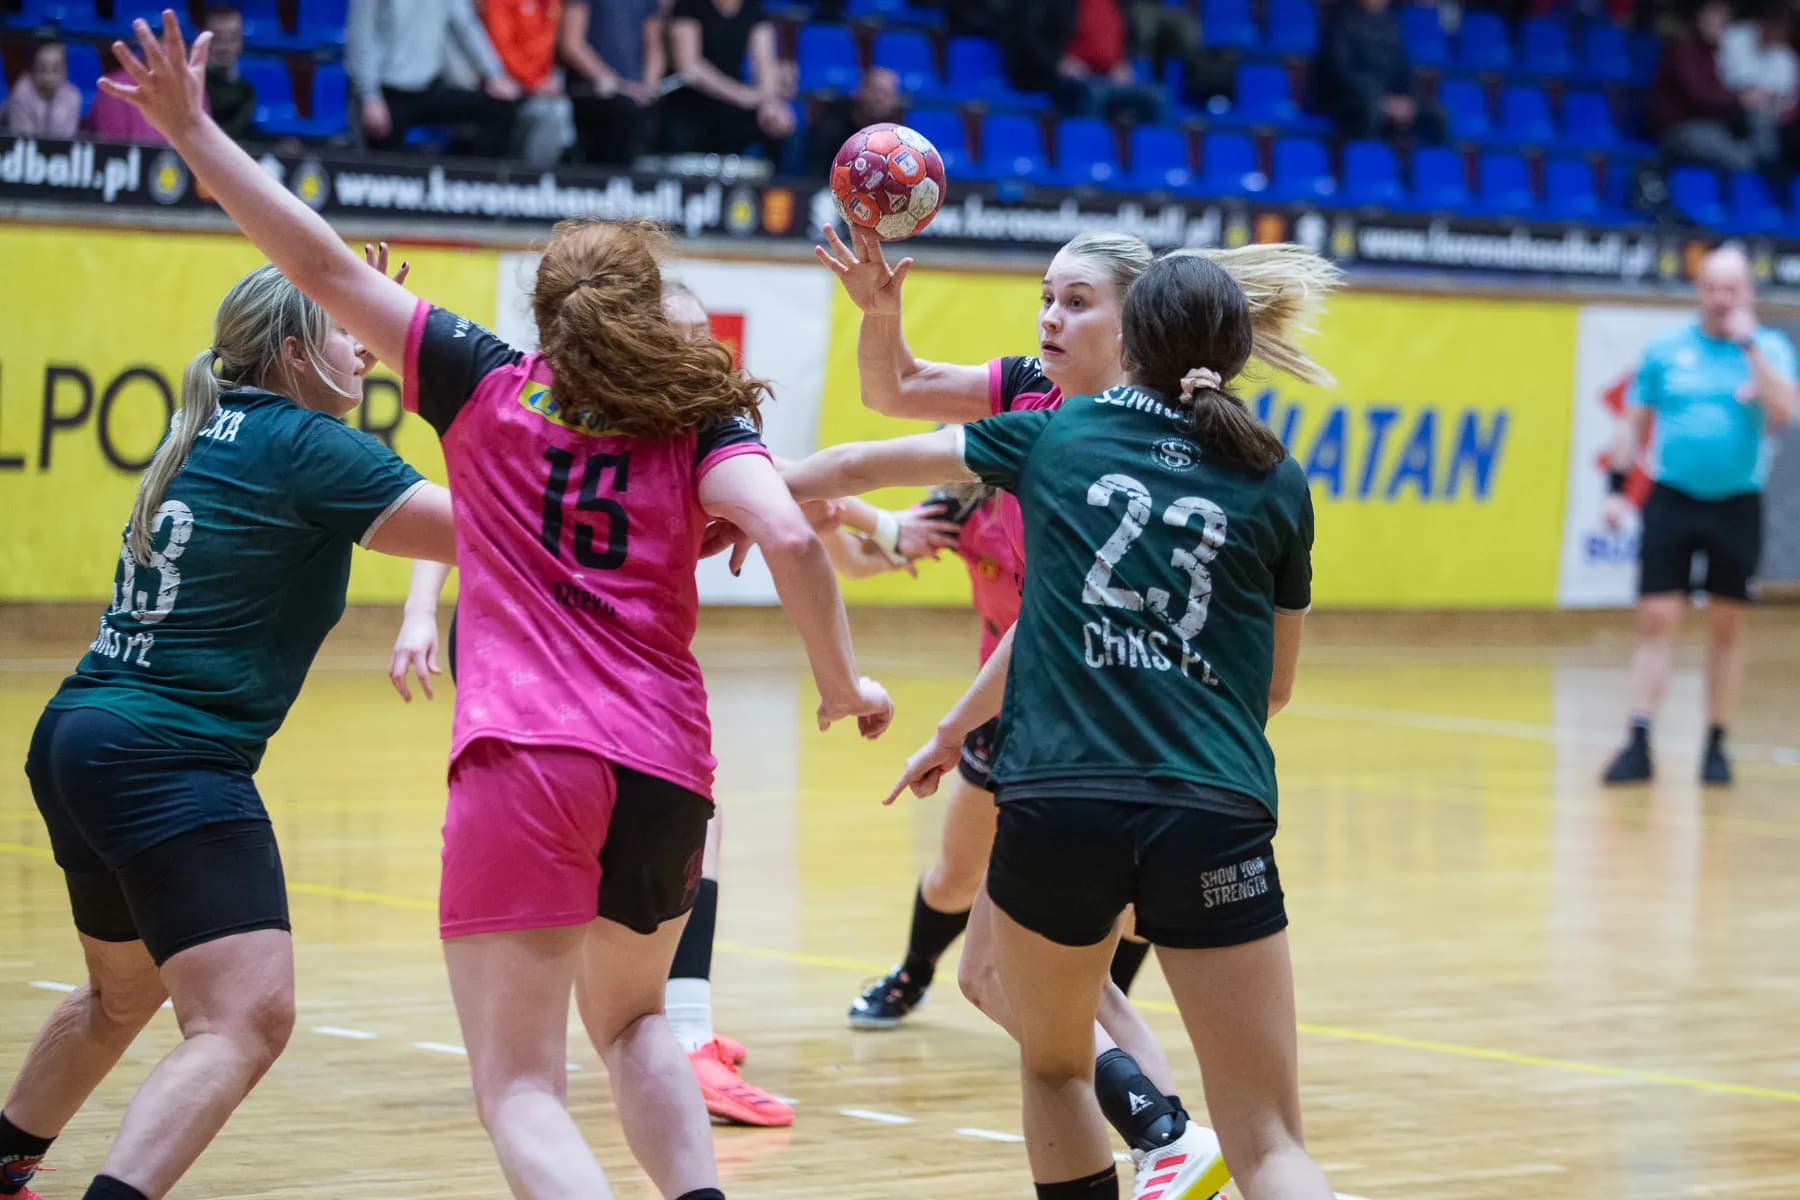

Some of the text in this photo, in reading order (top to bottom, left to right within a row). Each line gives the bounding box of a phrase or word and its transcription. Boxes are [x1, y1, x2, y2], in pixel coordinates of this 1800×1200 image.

[541, 446, 629, 570] 15
[1081, 473, 1228, 640] 23
[1200, 864, 1238, 889] SHOW
[1202, 874, 1269, 909] STRENGTH
